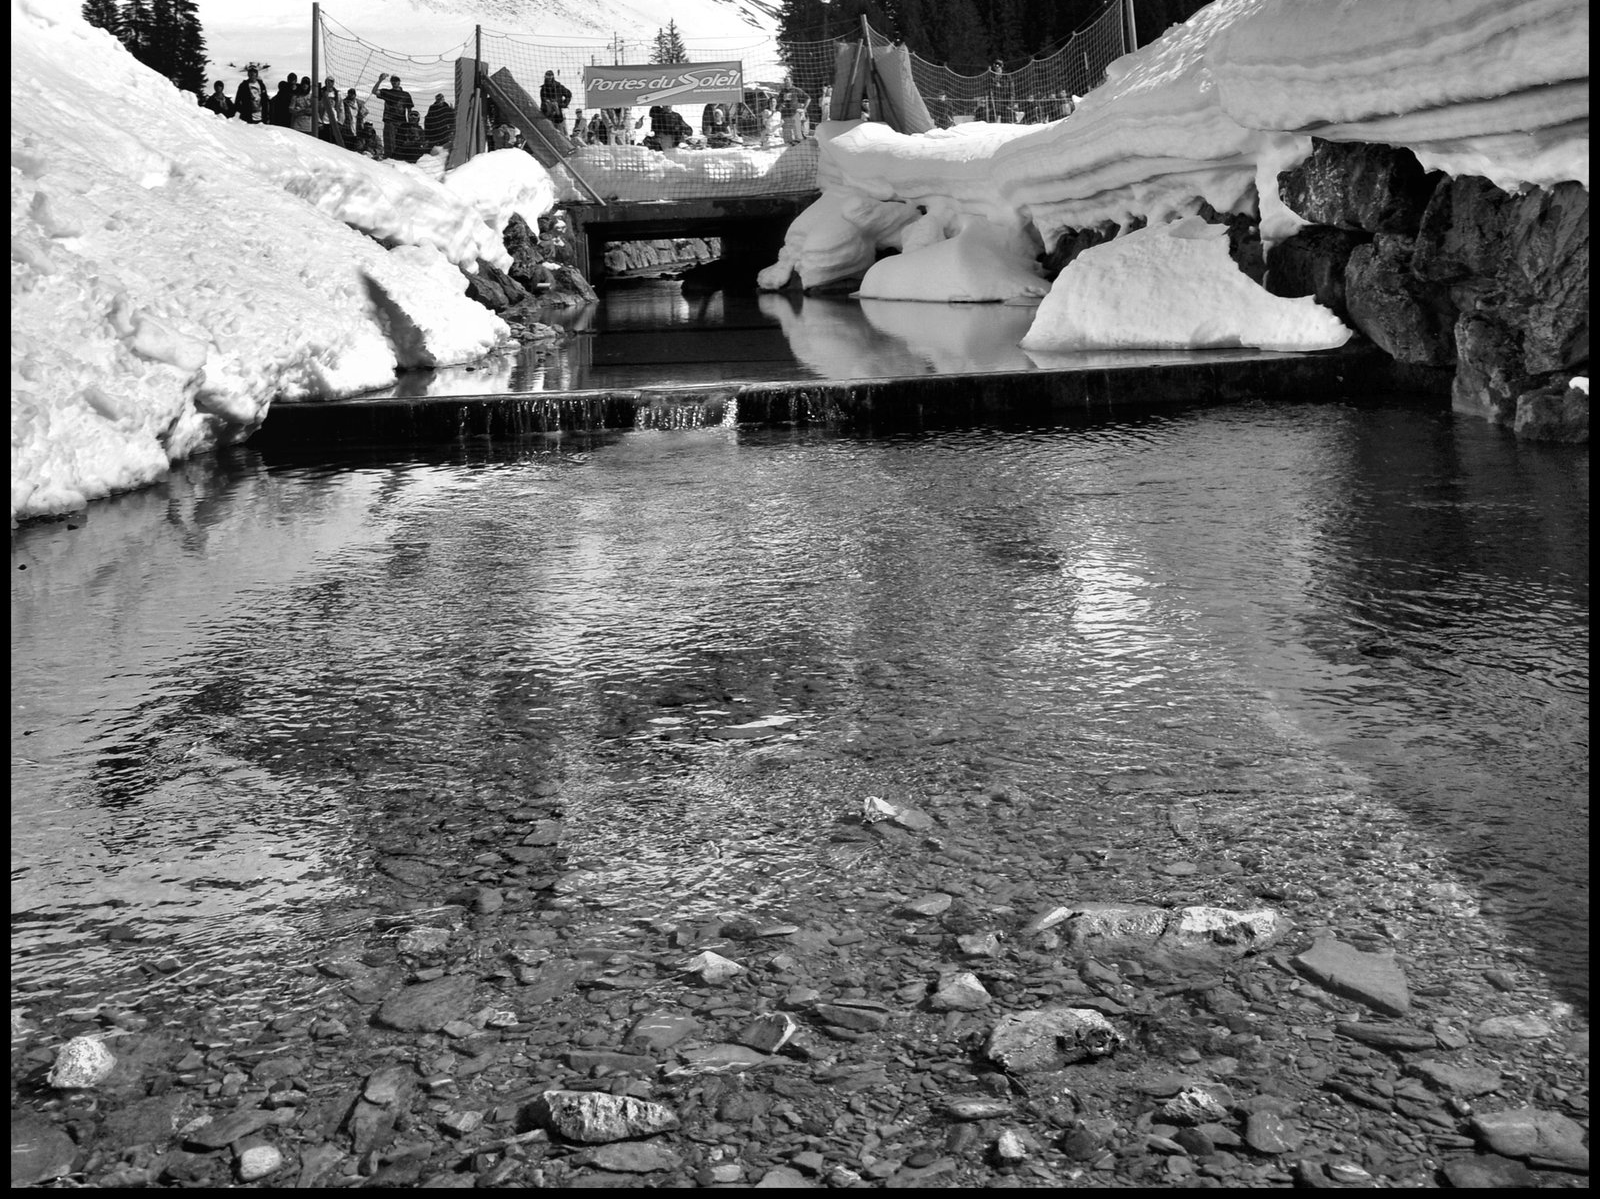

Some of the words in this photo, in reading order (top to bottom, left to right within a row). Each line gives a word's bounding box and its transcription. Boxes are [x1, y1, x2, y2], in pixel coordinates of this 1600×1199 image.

[586, 78, 648, 92] Portes
[648, 76, 676, 89] du
[677, 70, 741, 90] Soleil
